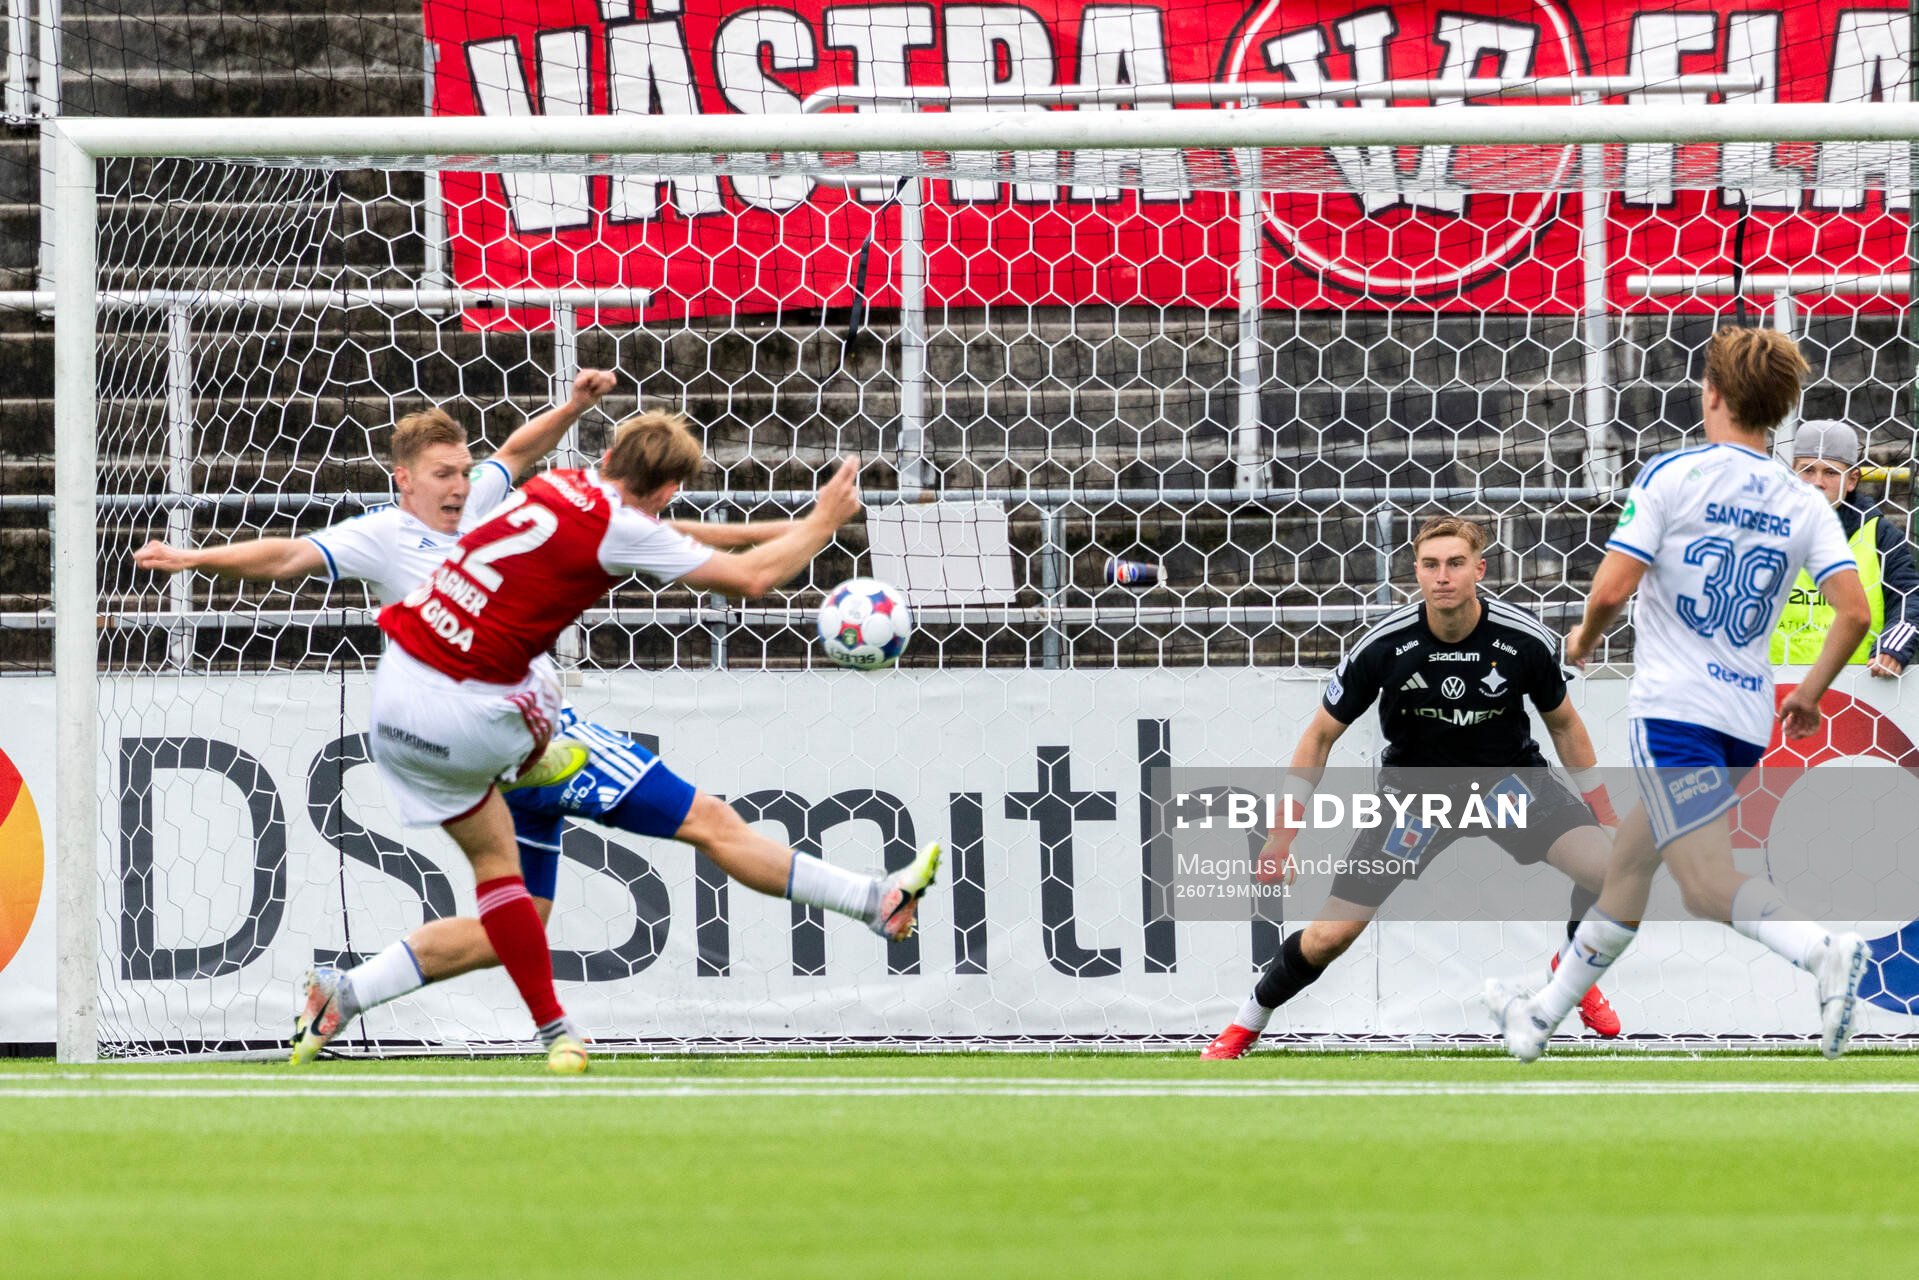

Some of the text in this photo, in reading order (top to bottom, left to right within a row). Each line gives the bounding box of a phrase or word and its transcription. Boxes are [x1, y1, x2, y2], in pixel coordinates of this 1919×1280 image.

[465, 0, 1192, 234] VÄSTRA
[1704, 502, 1791, 538] SANDBERG
[1676, 536, 1788, 648] 38
[1428, 651, 1480, 662] stadium
